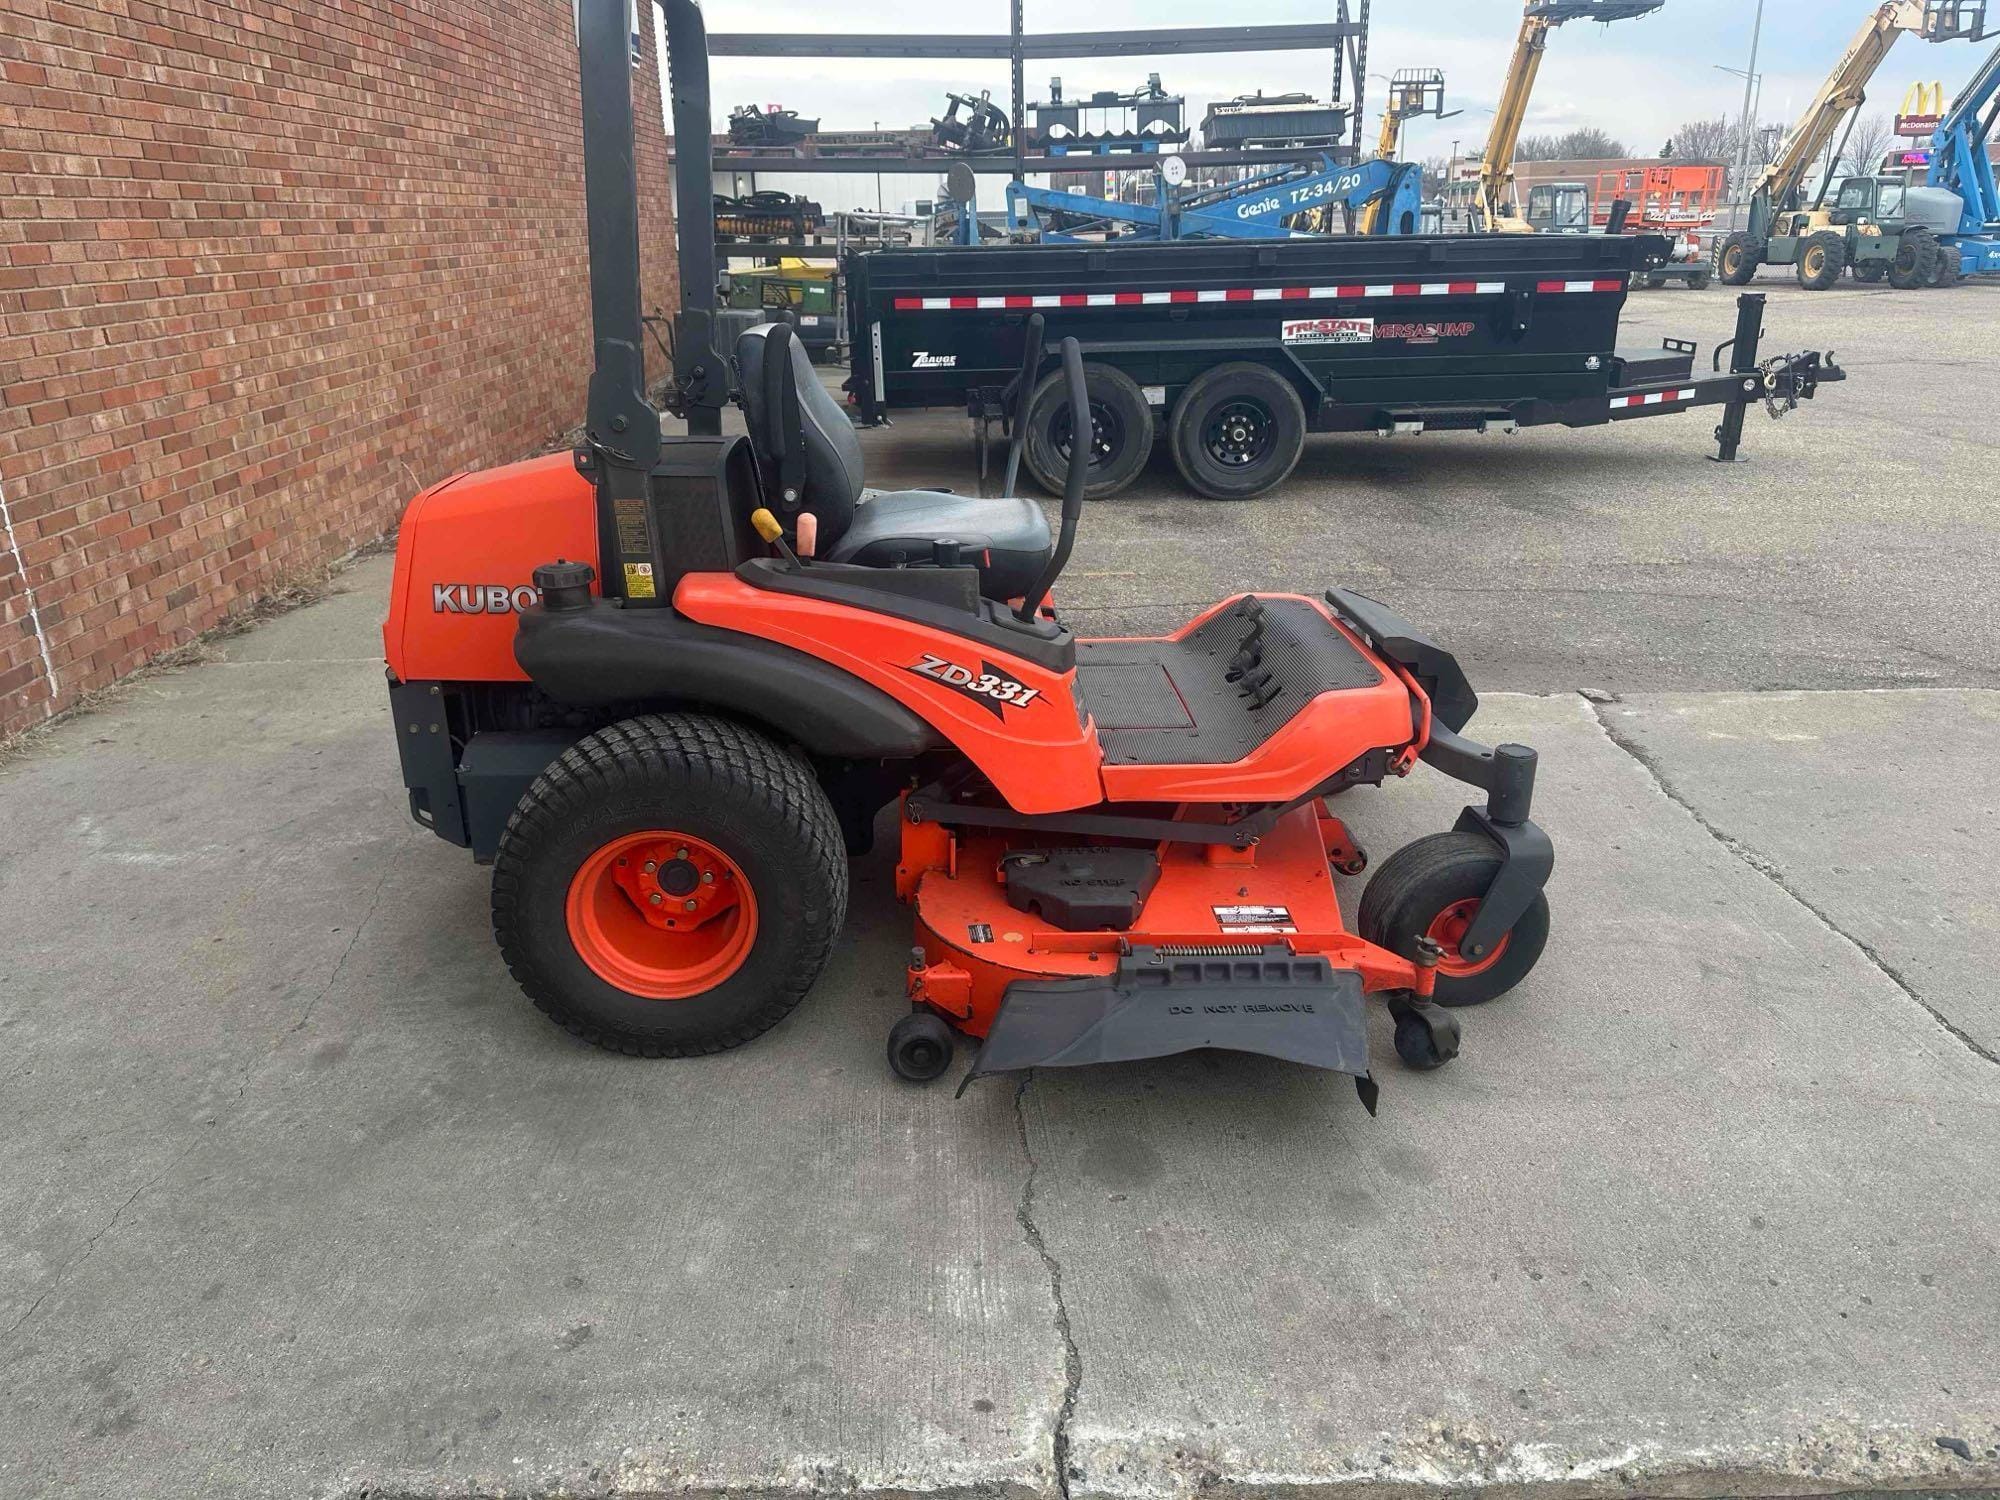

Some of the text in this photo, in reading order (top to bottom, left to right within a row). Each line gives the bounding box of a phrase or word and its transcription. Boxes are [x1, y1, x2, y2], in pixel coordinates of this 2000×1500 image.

[1832, 47, 1858, 82] GEHL
[1900, 121, 1940, 130] McDonald's
[1237, 173, 1361, 219] Genie TZ-34/20
[1284, 319, 1373, 337] TRI-STATE
[911, 653, 1042, 709] ZD331
[1168, 1003, 1316, 1015] DO NOT REMOVE
